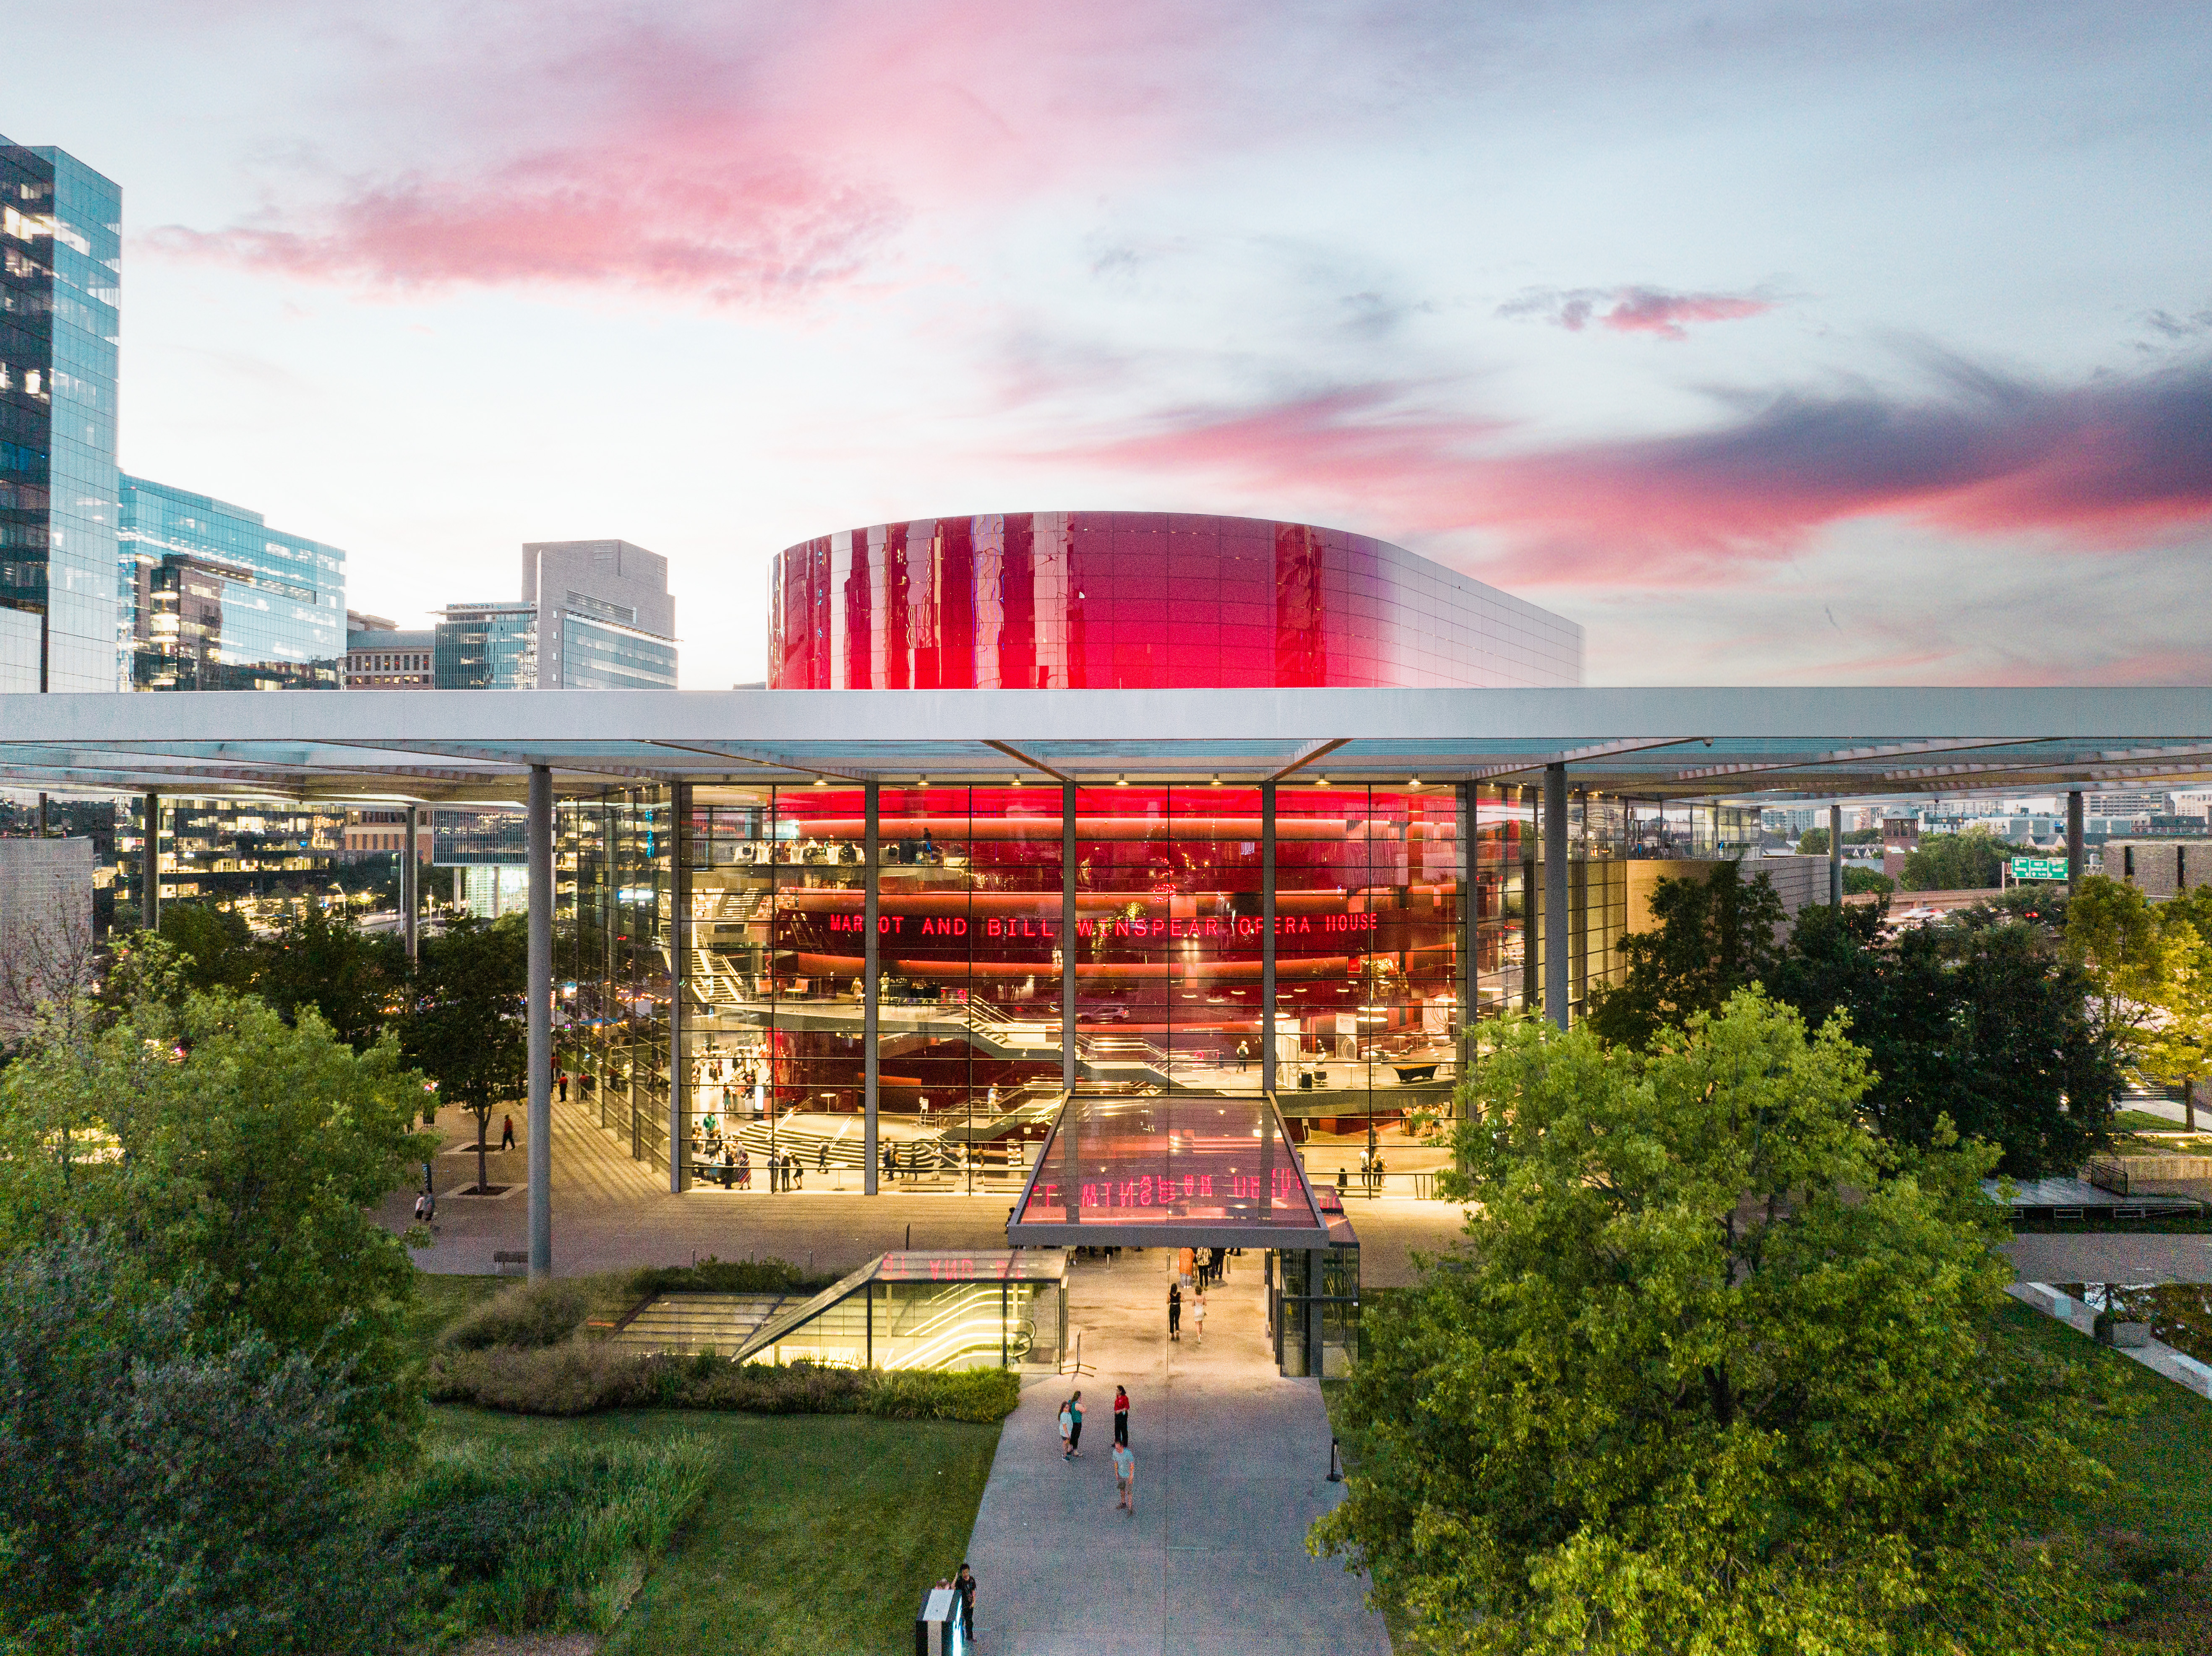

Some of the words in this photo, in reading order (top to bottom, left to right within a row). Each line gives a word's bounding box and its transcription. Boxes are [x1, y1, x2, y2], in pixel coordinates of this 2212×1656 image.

[830, 914, 904, 933] MAROT
[922, 917, 967, 936] AND
[987, 918, 1054, 937] BILL
[1077, 918, 1218, 937] WINSPEAR
[1325, 912, 1377, 932] HOUSE
